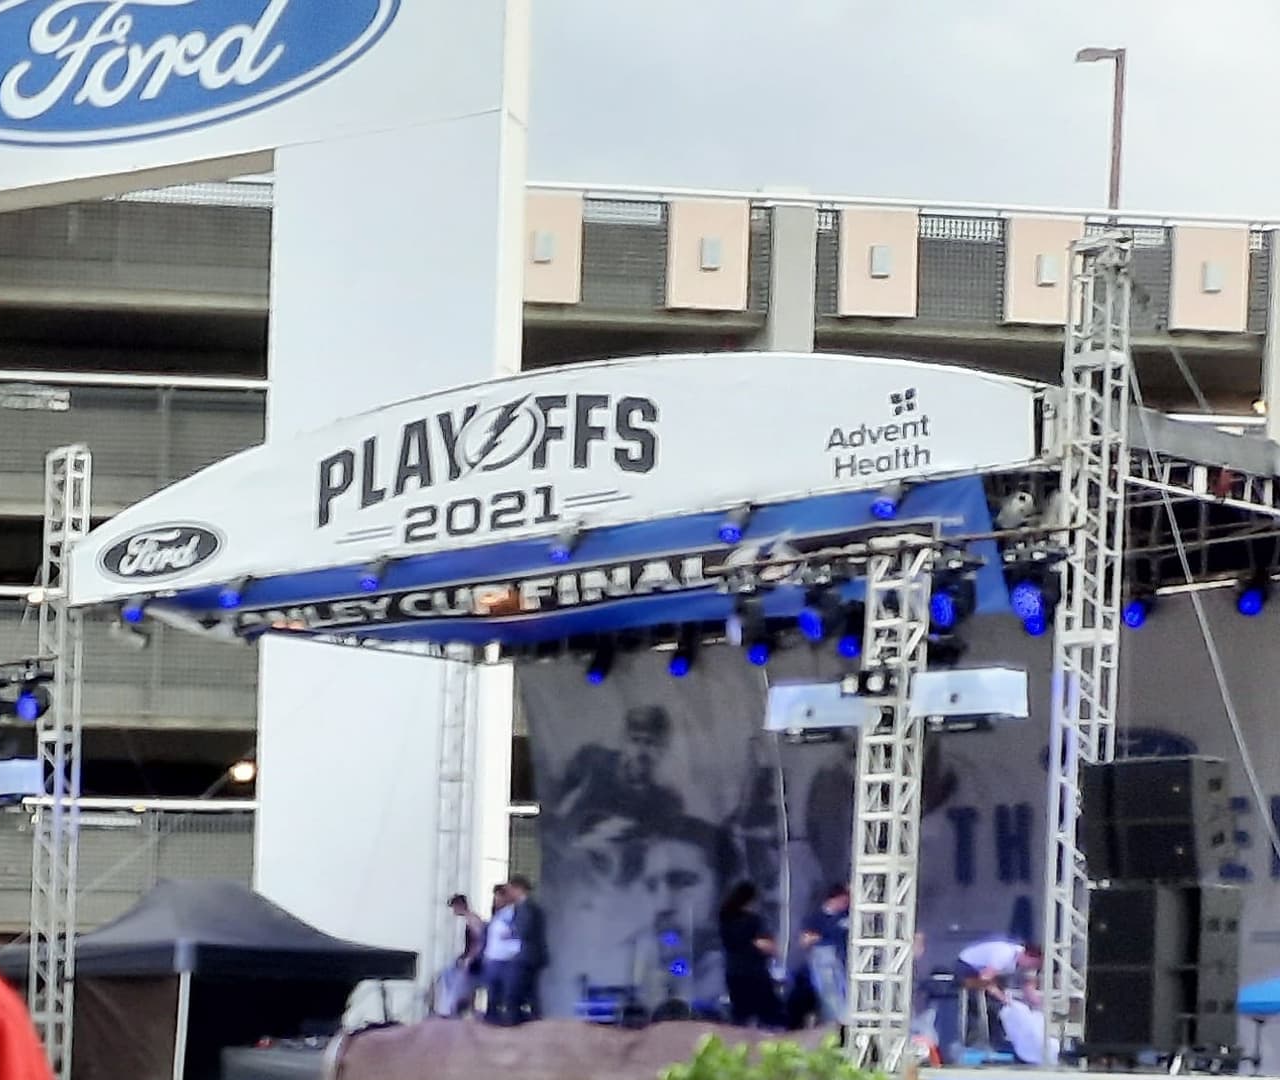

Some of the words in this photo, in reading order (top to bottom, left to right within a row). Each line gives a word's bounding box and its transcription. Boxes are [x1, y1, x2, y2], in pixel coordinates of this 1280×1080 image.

[826, 415, 931, 452] Advent
[834, 444, 931, 478] Health
[404, 485, 561, 544] 2021
[119, 530, 202, 576] Ford
[398, 583, 512, 617] CUP
